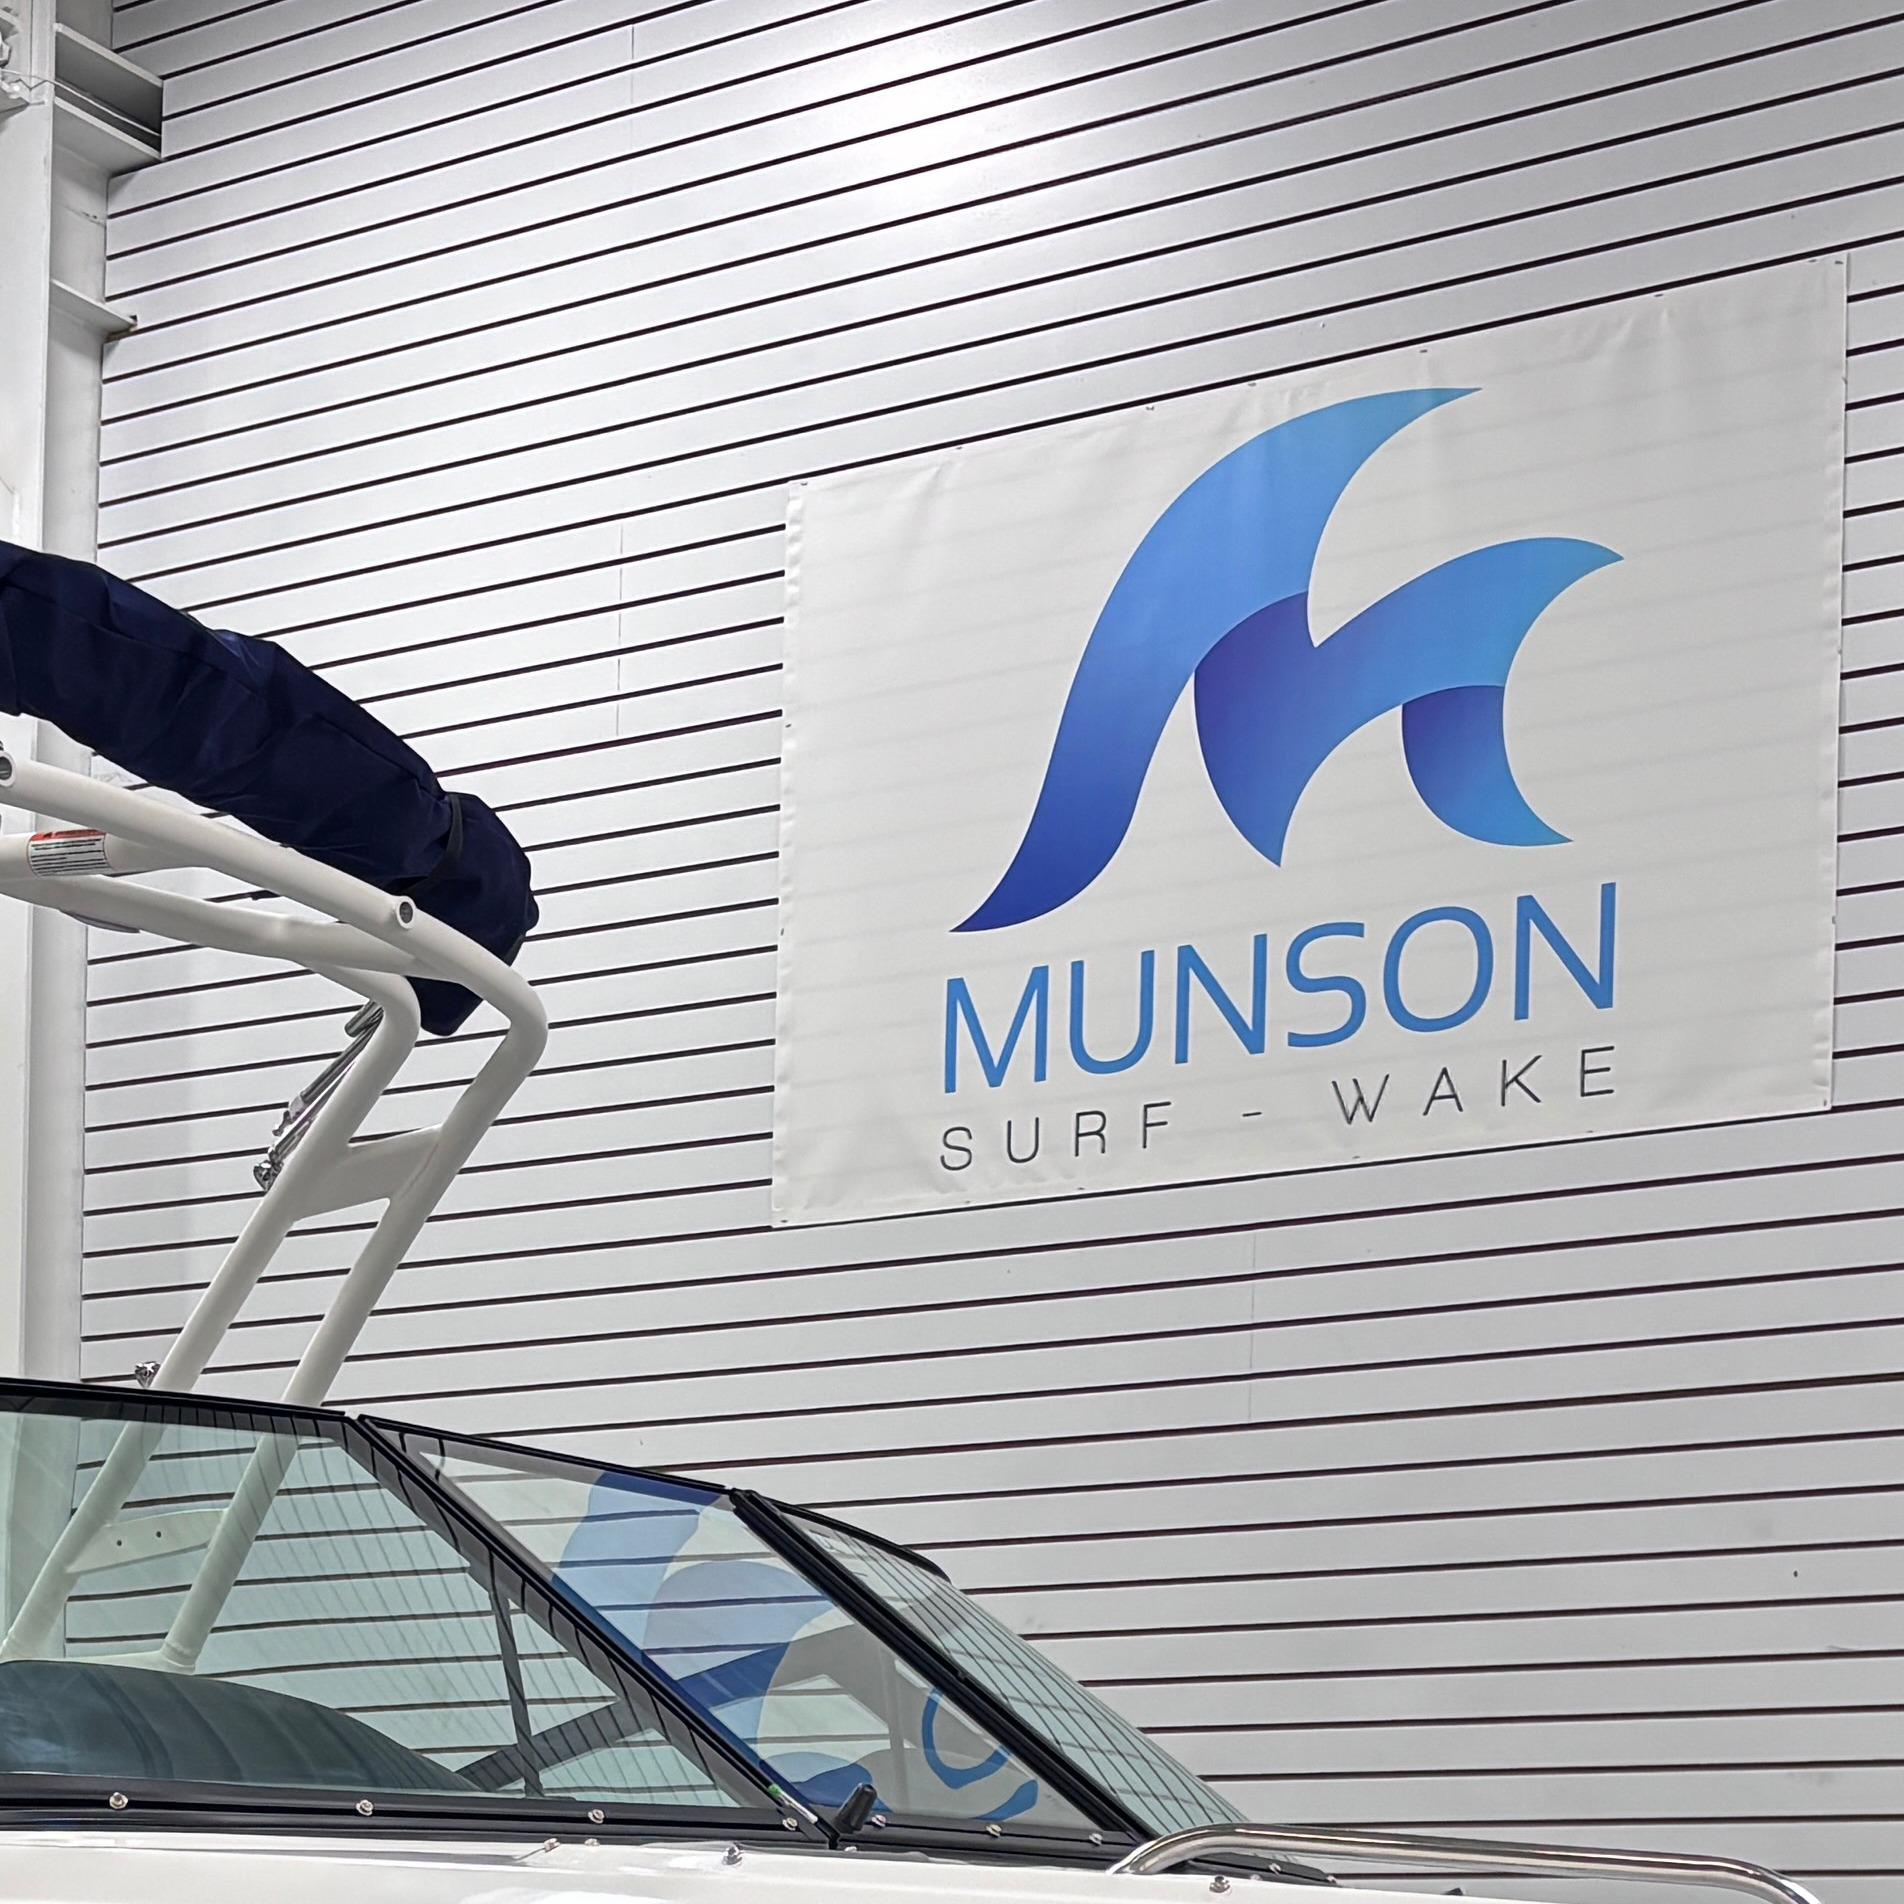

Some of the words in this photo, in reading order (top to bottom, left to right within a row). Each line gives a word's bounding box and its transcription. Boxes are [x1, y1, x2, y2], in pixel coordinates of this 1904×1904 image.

[943, 881, 1618, 1095] MUNSON
[939, 1100, 1174, 1171] SURF
[1330, 1044, 1616, 1127] WAKE
